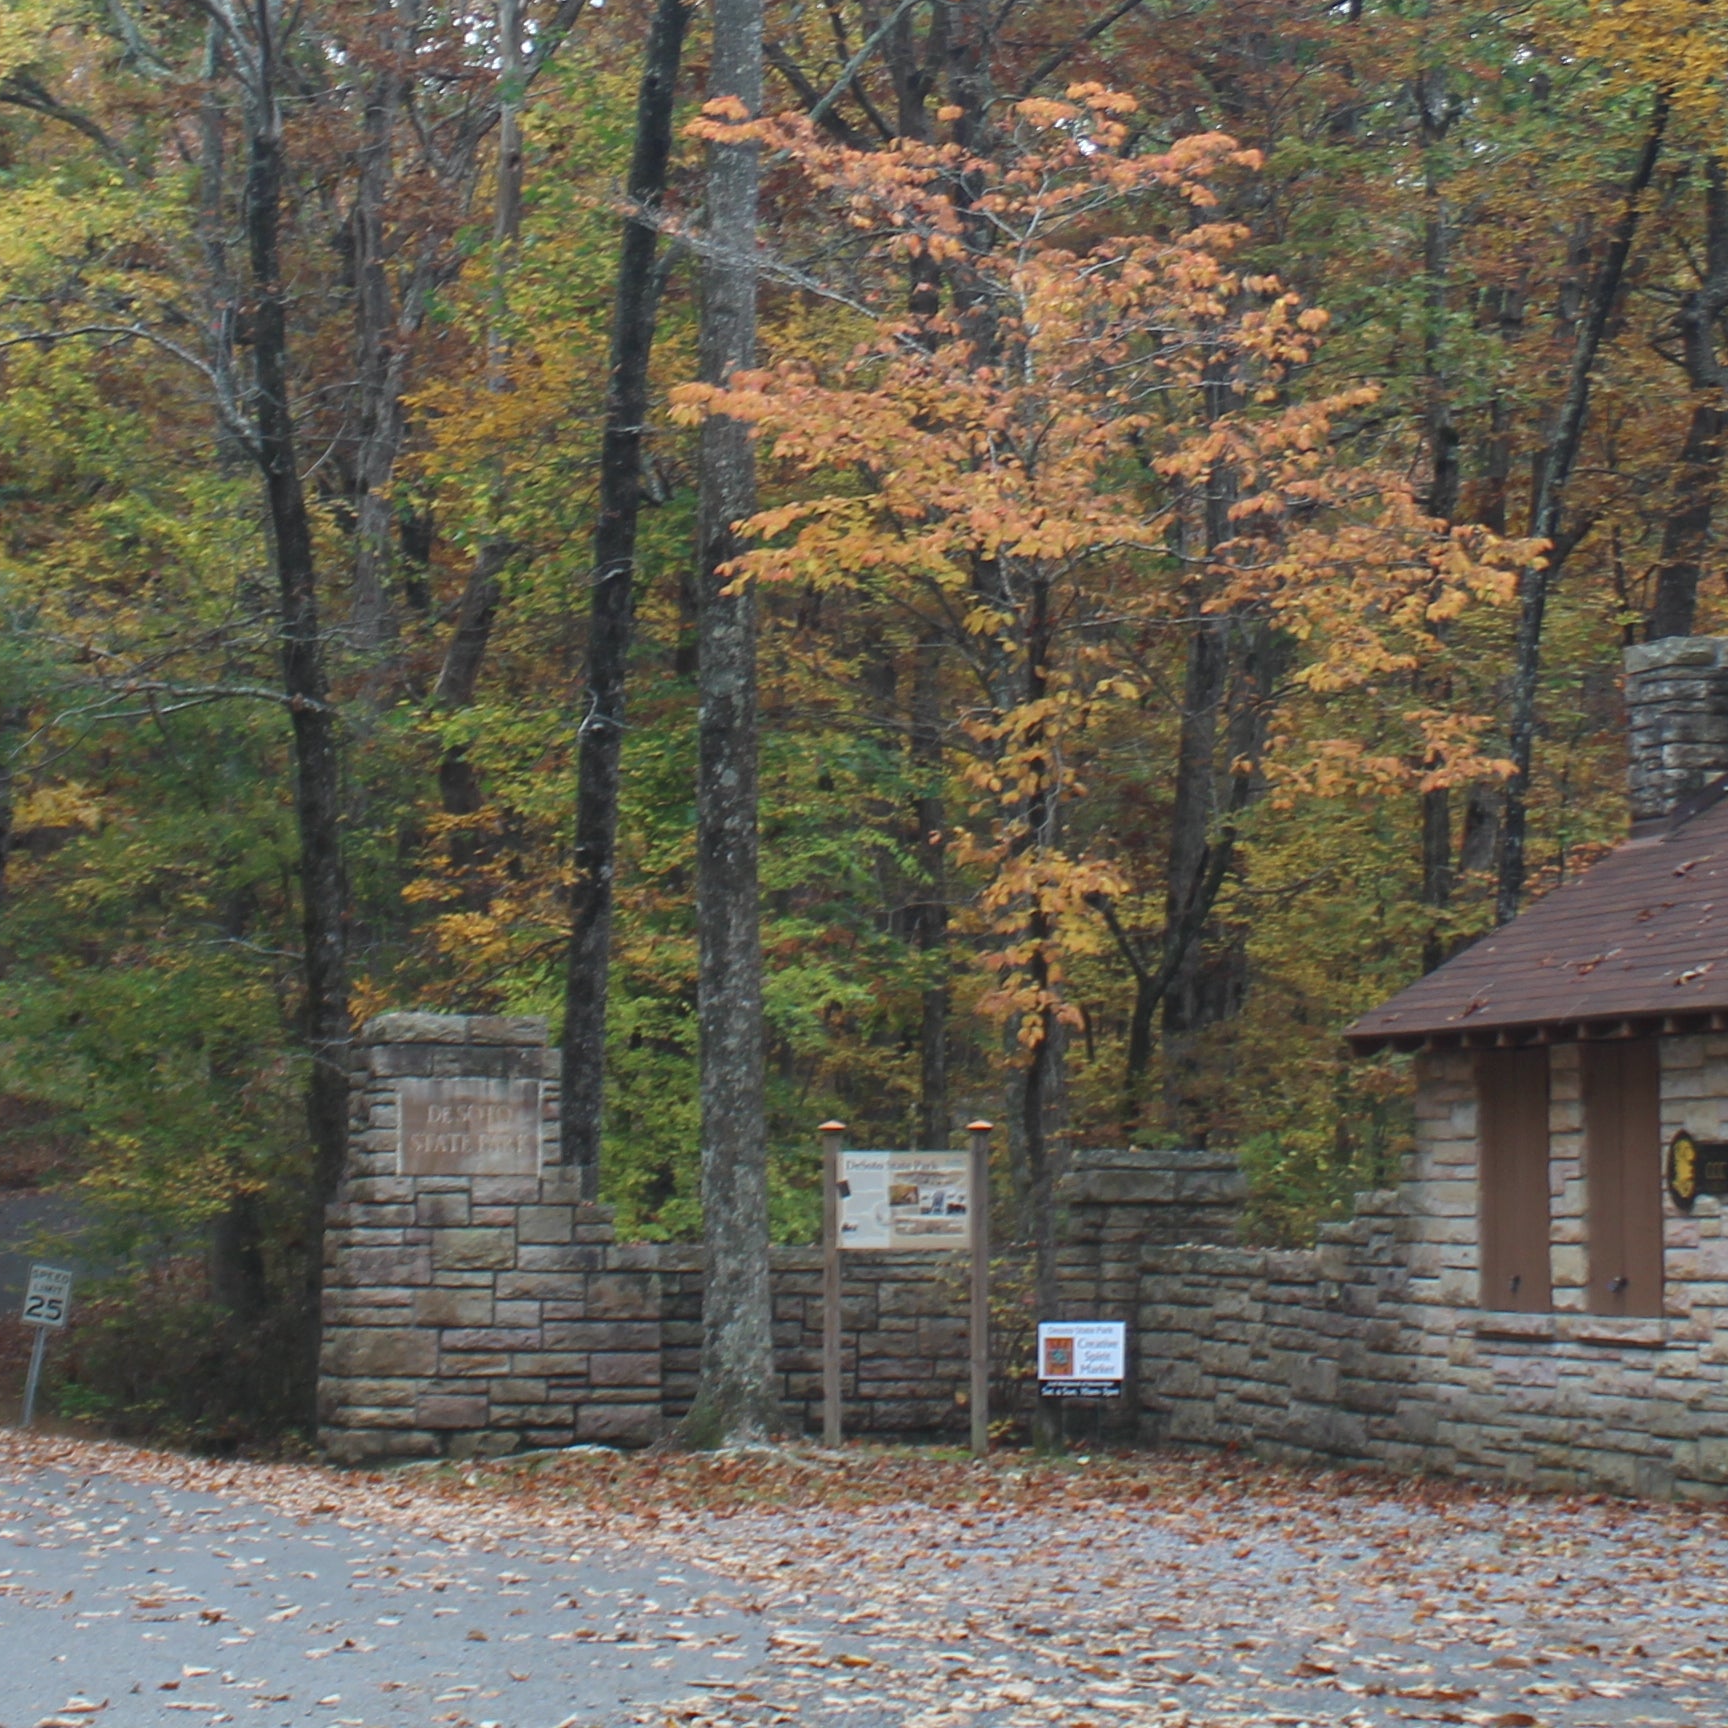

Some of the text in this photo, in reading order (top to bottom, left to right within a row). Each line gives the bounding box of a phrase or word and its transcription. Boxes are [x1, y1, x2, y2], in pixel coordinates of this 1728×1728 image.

[410, 1133, 473, 1154] STATE
[887, 1159, 911, 1170] State
[913, 1159, 939, 1170] Park
[32, 1269, 69, 1284] SPEED
[33, 1283, 62, 1294] LIMIT
[26, 1295, 63, 1320] 25
[1076, 1325, 1095, 1334] State
[1096, 1325, 1114, 1334] Park
[1077, 1337, 1119, 1350] Creative
[1084, 1350, 1111, 1363] Spirit
[1079, 1363, 1115, 1374] Market
